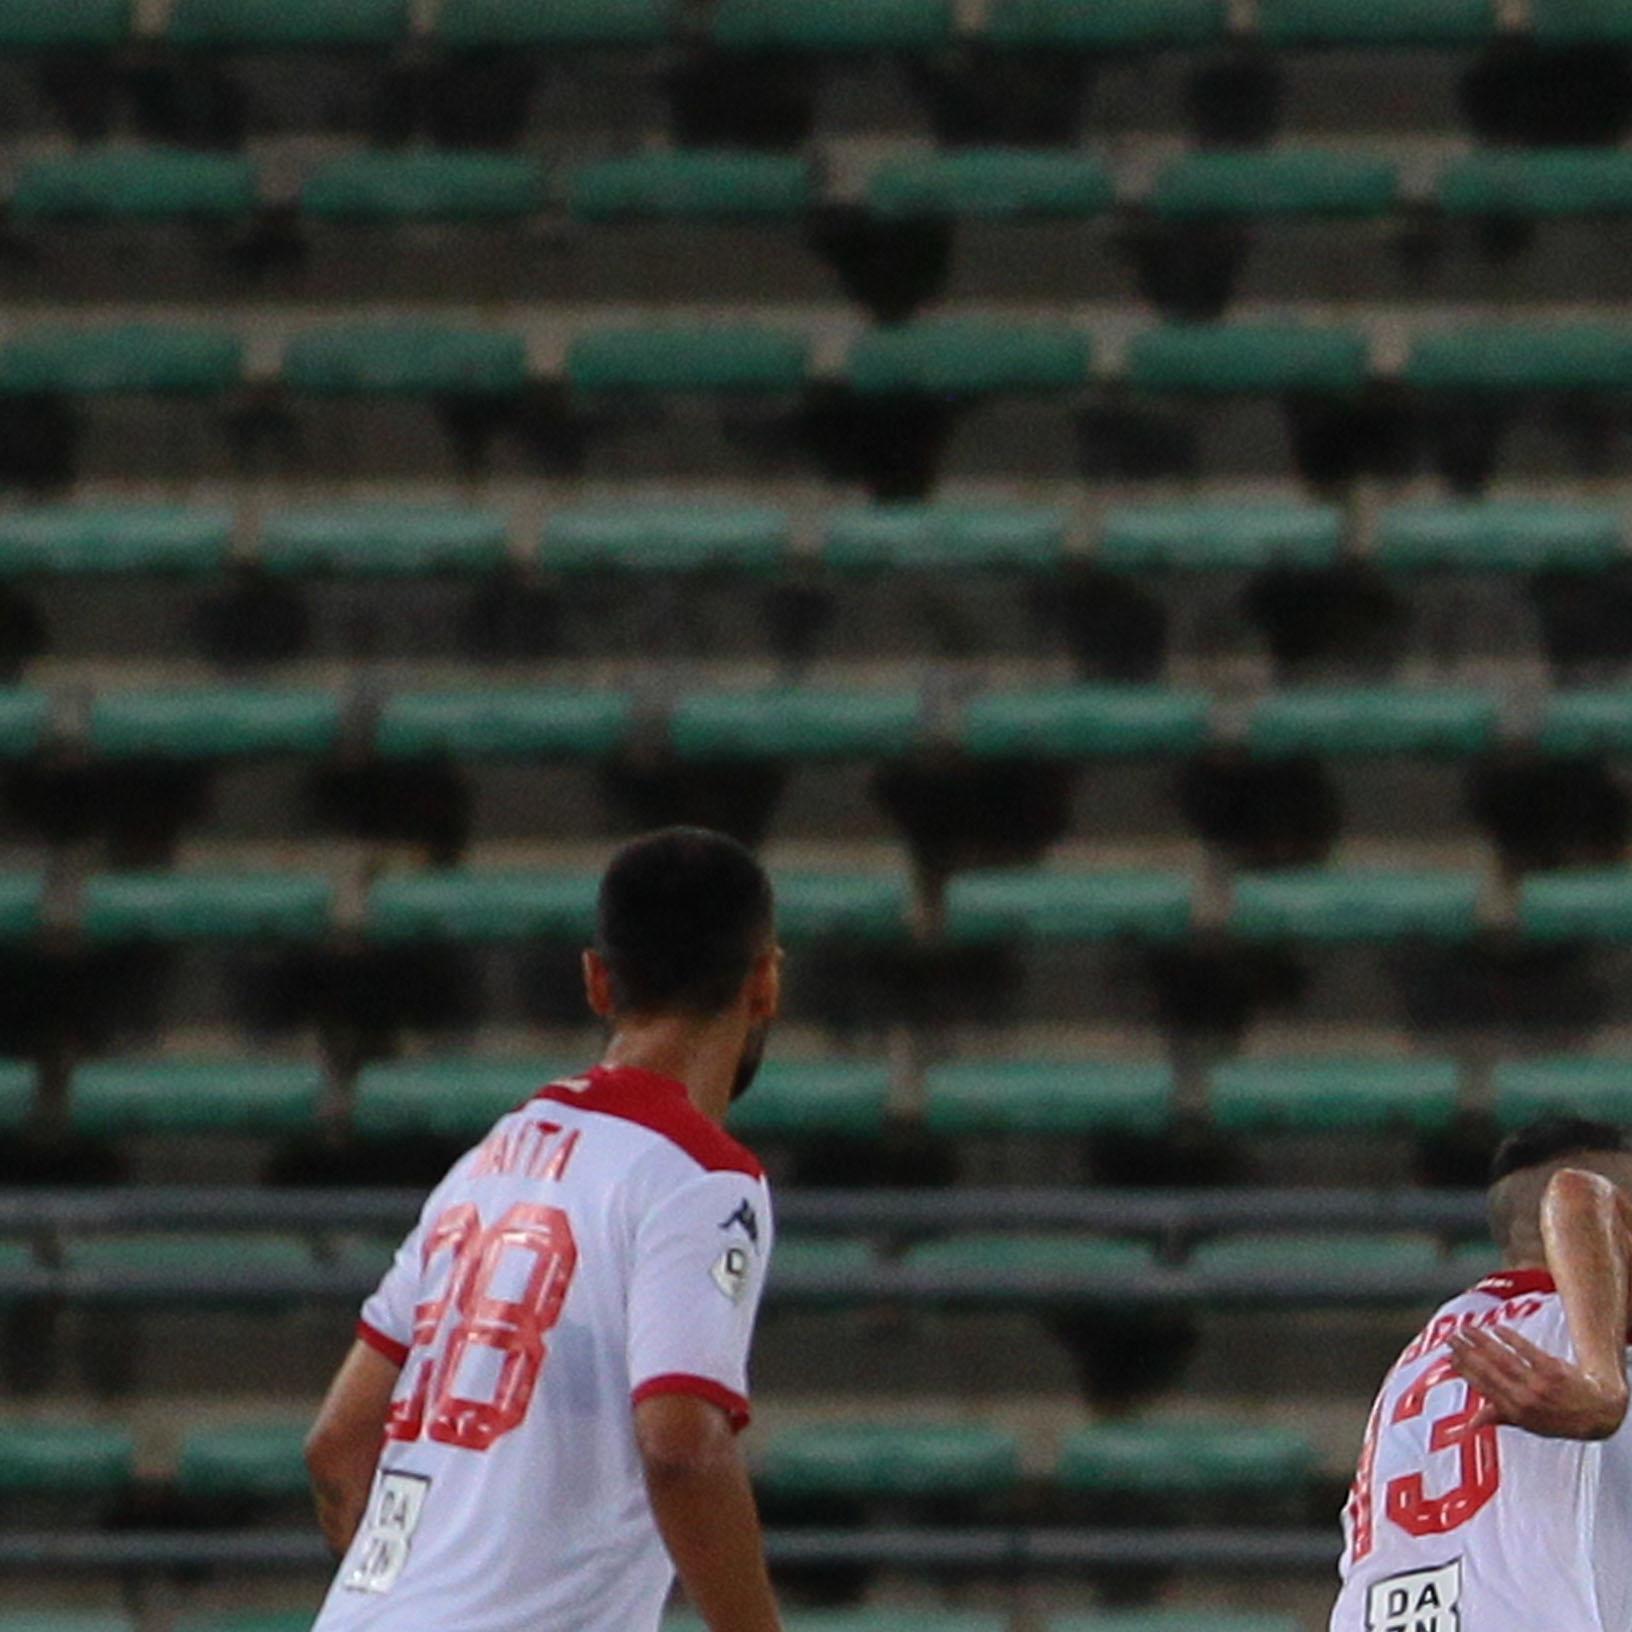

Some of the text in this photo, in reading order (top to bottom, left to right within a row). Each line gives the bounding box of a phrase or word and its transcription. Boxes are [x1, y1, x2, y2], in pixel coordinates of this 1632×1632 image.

[384, 1200, 578, 1452] 38
[1350, 1353, 1500, 1564] 13
[1388, 1582, 1440, 1618] DA
